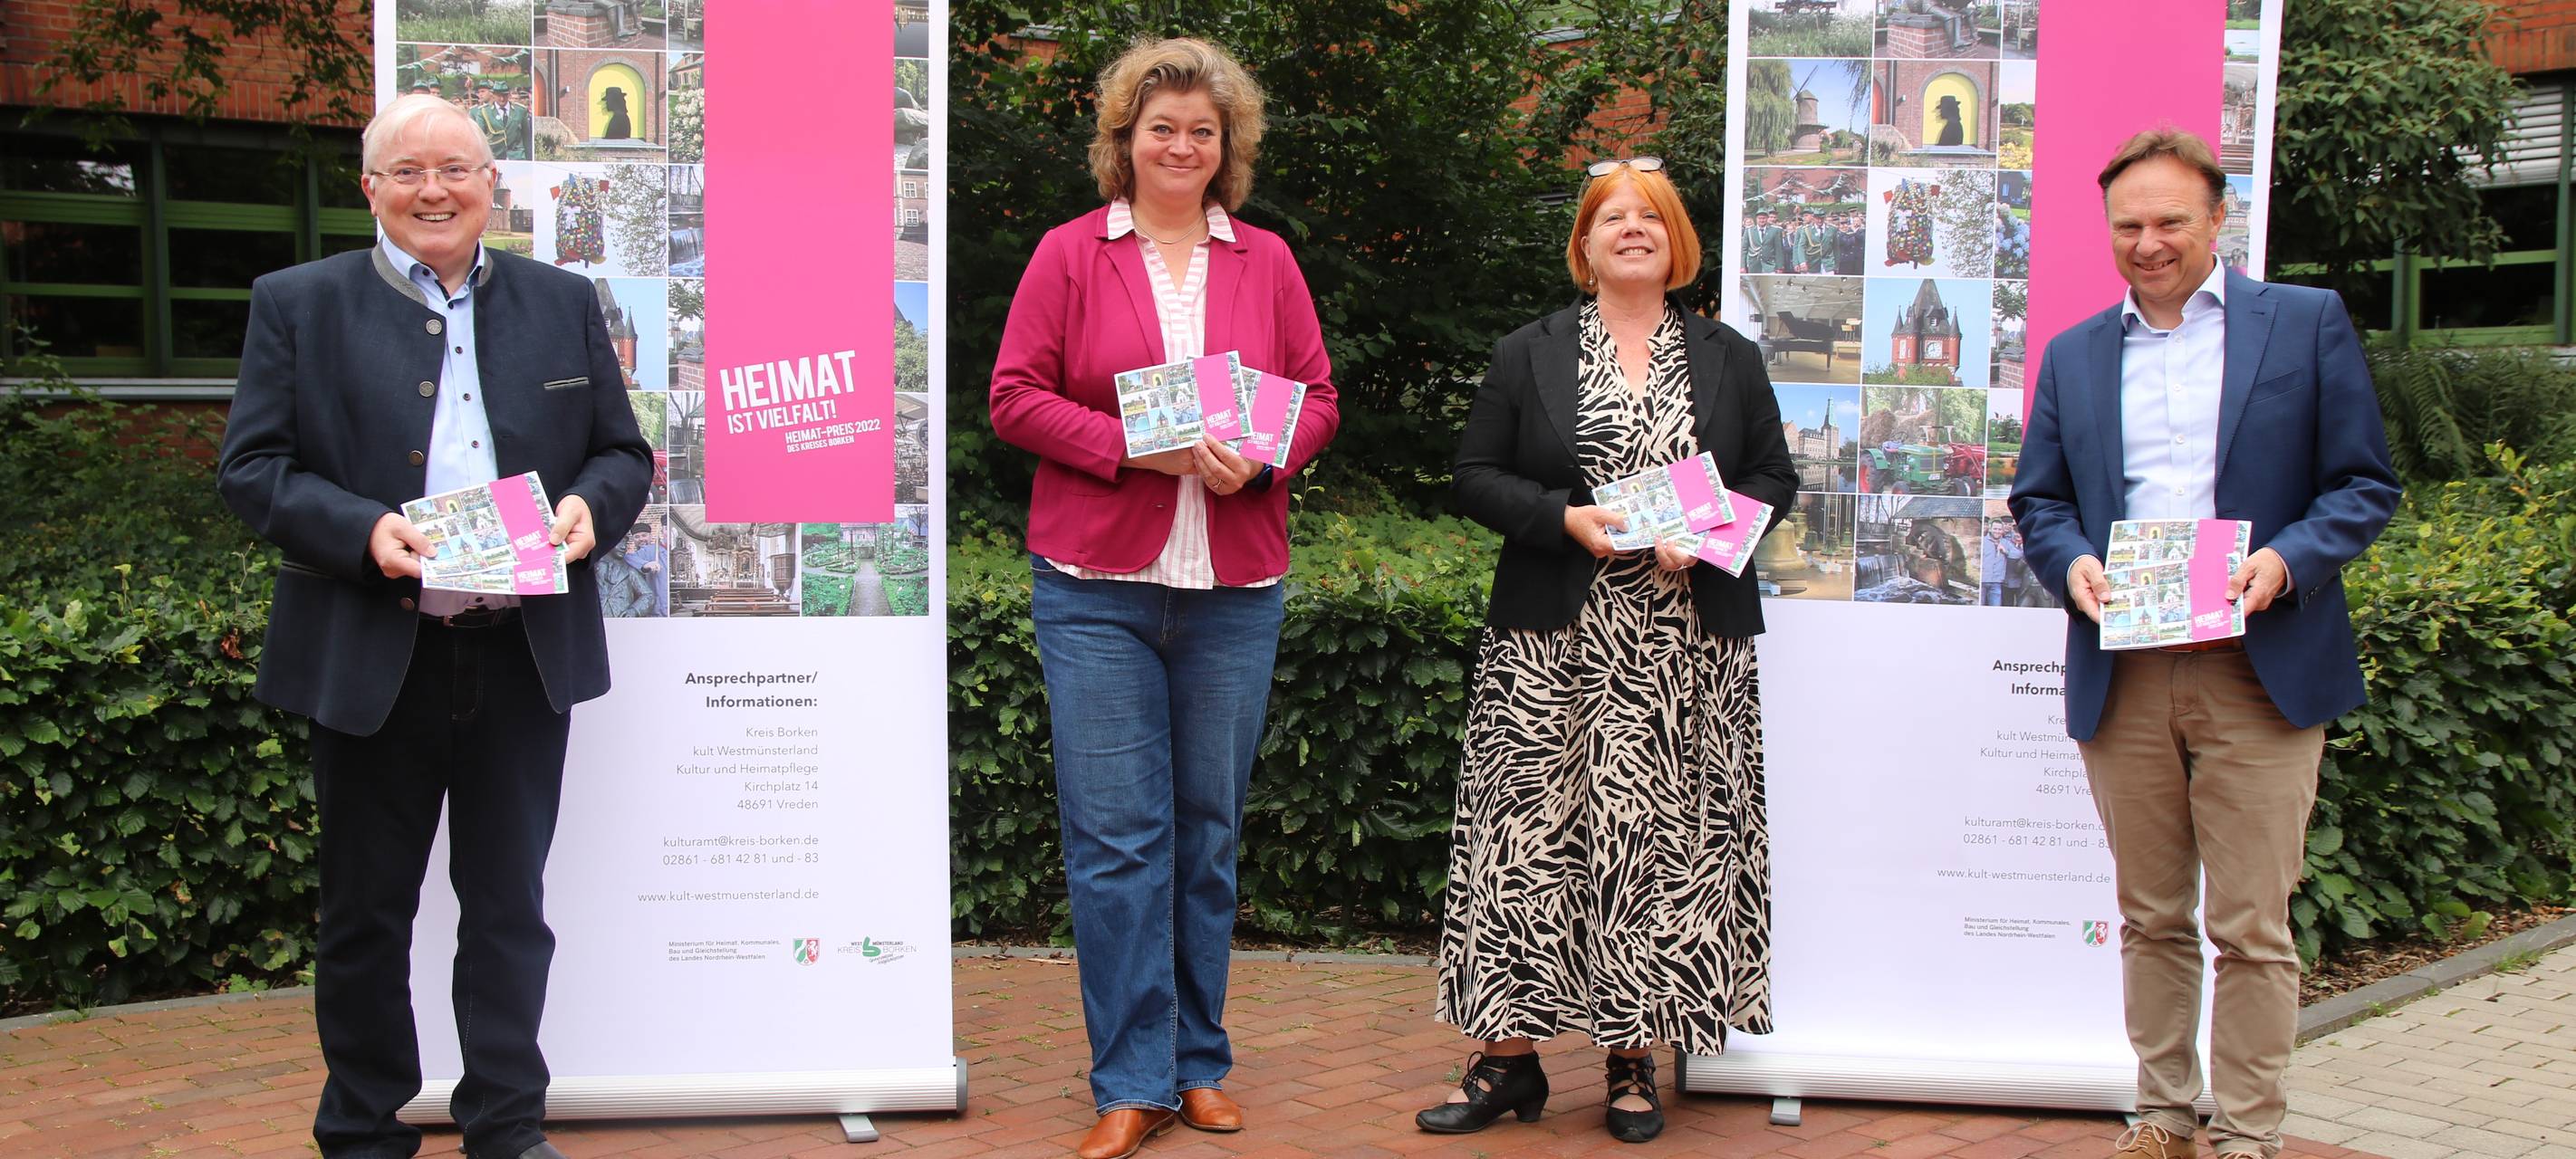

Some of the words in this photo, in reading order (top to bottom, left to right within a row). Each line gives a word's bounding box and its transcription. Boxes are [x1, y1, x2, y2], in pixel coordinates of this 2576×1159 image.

[720, 350, 856, 411] HEIMAT
[727, 412, 754, 434] IST
[757, 399, 837, 429] VIELFALT!
[785, 423, 854, 444] HEIMAT-PREIS
[855, 418, 881, 434] 2022
[787, 444, 800, 453] DES
[801, 439, 828, 451] KREISES
[828, 436, 855, 446] BORKEN
[1993, 660, 2065, 675] Ansprechp
[685, 671, 818, 687] Ansprechpartner/
[2011, 683, 2064, 696] Informa
[706, 695, 818, 709] Informationen:
[2048, 714, 2065, 725] Kre
[745, 727, 774, 738] Kreis
[777, 726, 819, 737] Borken
[1996, 731, 2016, 741] kult
[693, 745, 714, 757] kult
[716, 743, 819, 756] Westmünsterland
[1980, 747, 2013, 758] Kultur
[2015, 749, 2037, 759] und
[2040, 750, 2083, 762] Heimat
[676, 763, 711, 775] Kultur
[714, 763, 736, 774] und
[739, 761, 819, 776] Heimatpflege
[2043, 768, 2088, 779] Kirchpla
[744, 781, 801, 794] Kirchplatz
[804, 781, 819, 790] 14
[2035, 784, 2070, 795] 48691
[2073, 786, 2092, 796] Vre
[736, 799, 774, 810] 48691
[776, 799, 819, 809] Vreden
[1965, 816, 2106, 831] kulturamt@kreis-borken.
[663, 835, 819, 848] kulturamt@kreis-borken.de
[1963, 833, 1997, 845] 02861
[2008, 835, 2028, 845] 681
[2032, 836, 2047, 847] 42
[2049, 837, 2062, 848] 81
[2066, 838, 2088, 848] und
[662, 854, 698, 866] 02861
[710, 853, 732, 865] 681
[735, 852, 751, 864] 42
[754, 852, 767, 864] 81
[772, 852, 794, 864] und
[804, 852, 819, 863] 83
[1937, 869, 2111, 884] www.kult-westmuensterland.de
[638, 888, 819, 902] www.kult-westmuensterland.de
[837, 945, 861, 954] KREIS
[882, 944, 917, 953] BORKEN
